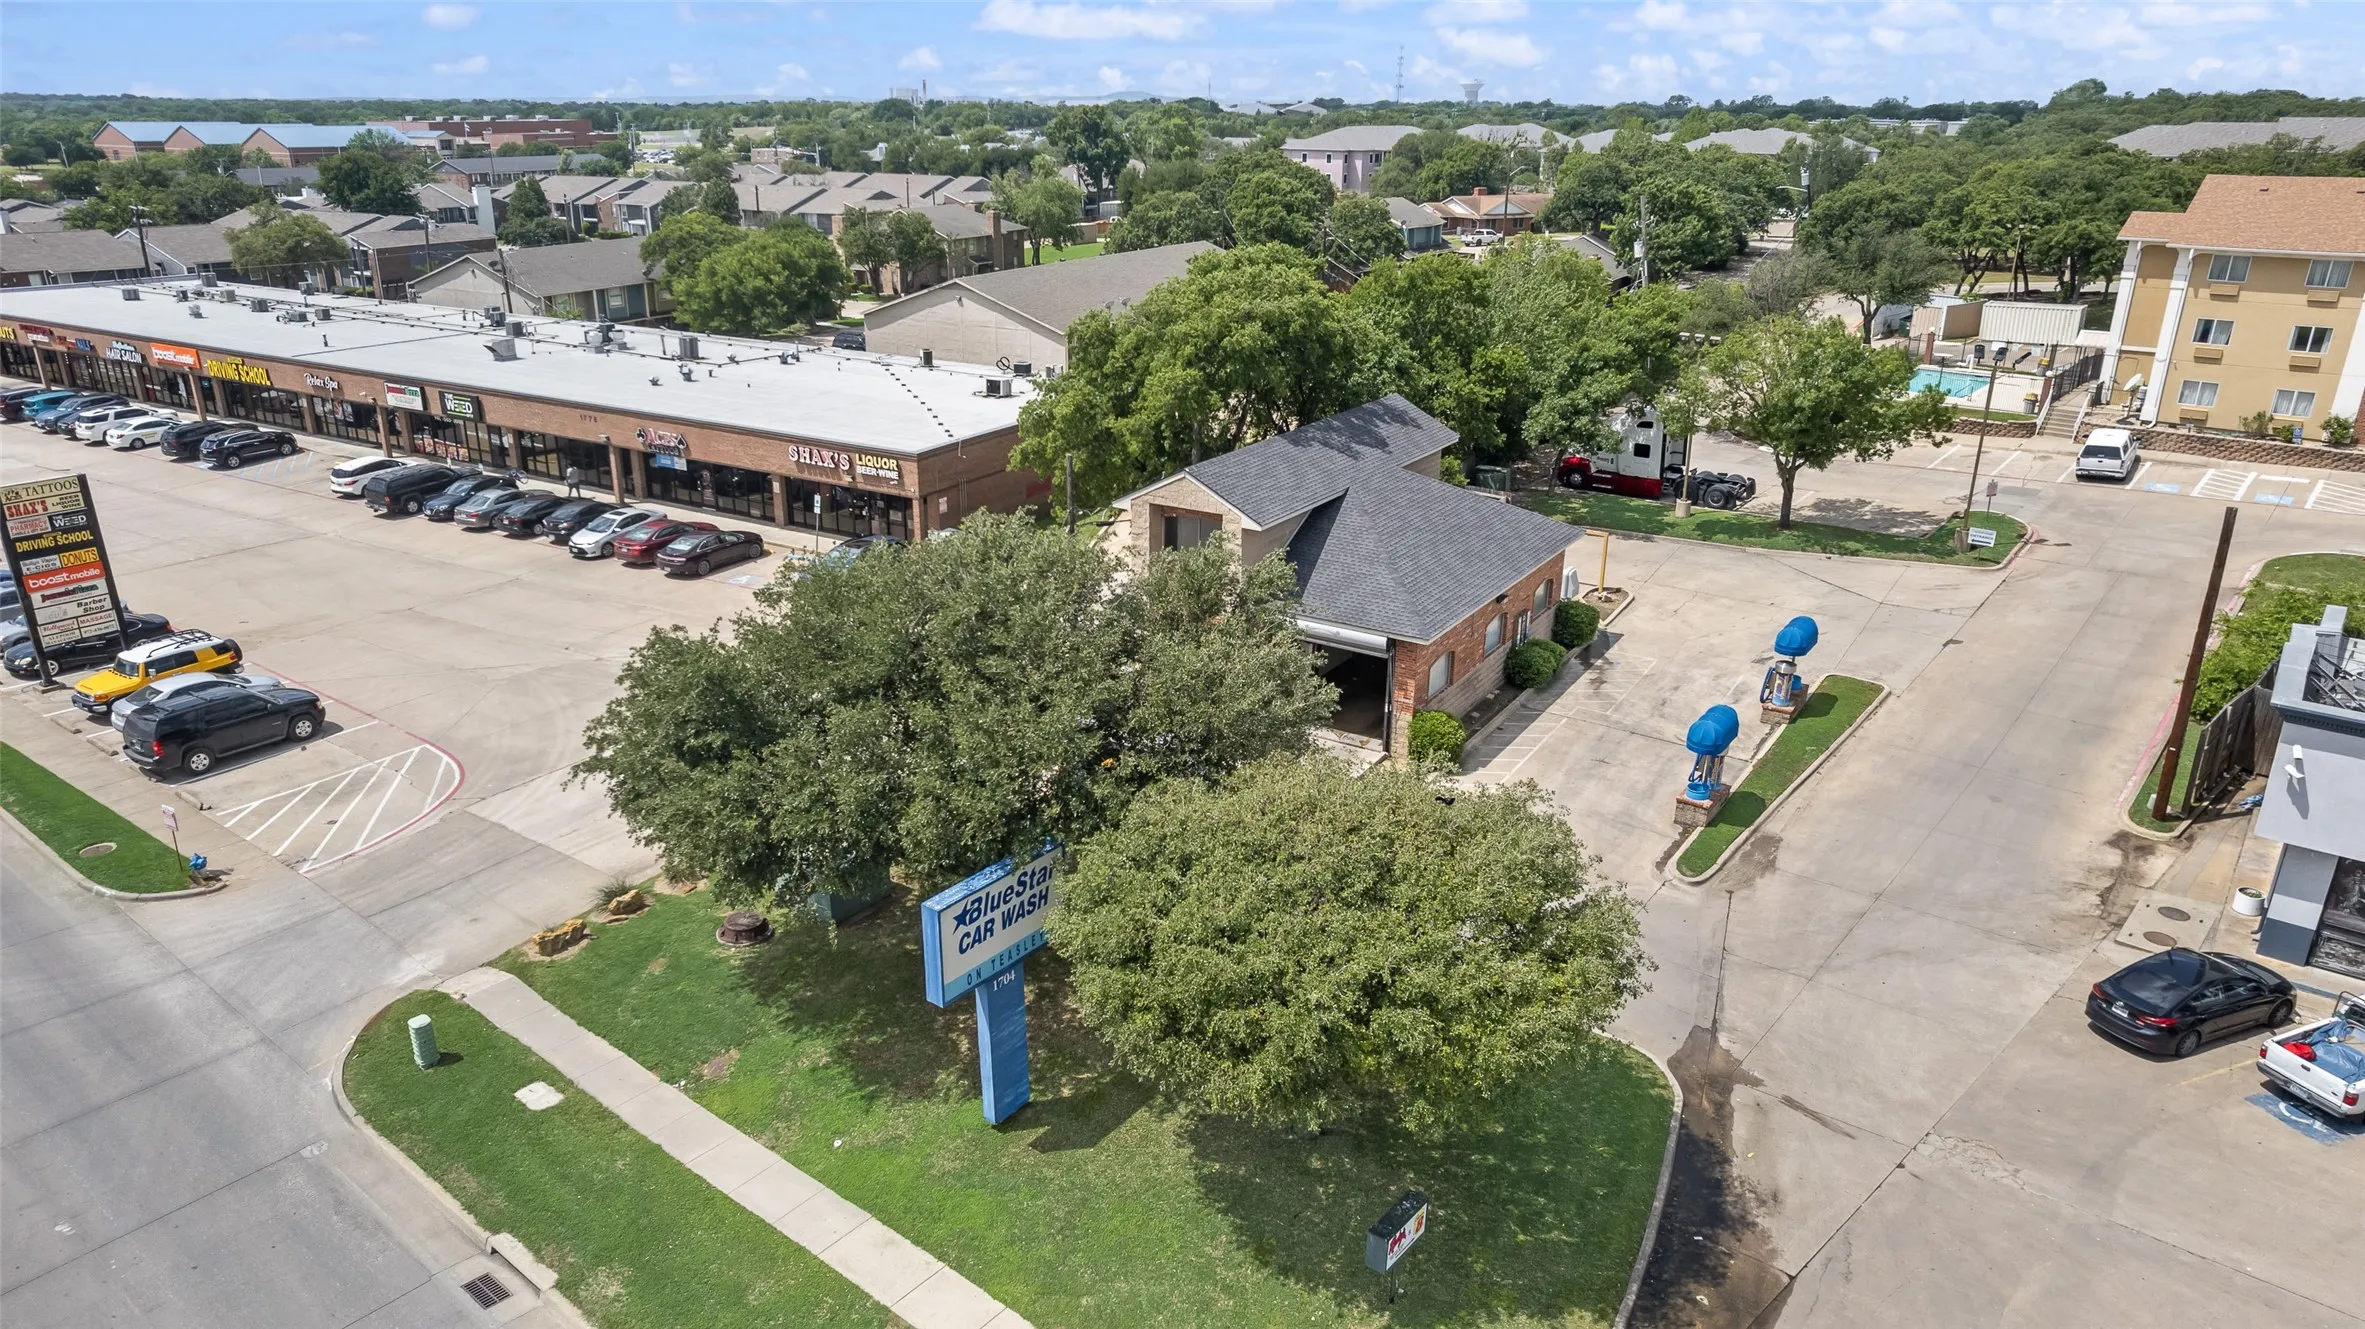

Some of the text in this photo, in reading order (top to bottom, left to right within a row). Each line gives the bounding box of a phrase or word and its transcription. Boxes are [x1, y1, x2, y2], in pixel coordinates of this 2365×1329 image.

[106, 347, 142, 363] HAIR SALON
[207, 359, 239, 380] DRIVING
[238, 364, 271, 385] SCHOOL
[304, 373, 339, 391] Relax Spa
[788, 445, 898, 471] SHAX'S LIQUOR
[22, 479, 78, 496] TATTOOS
[6, 500, 48, 518] SHAX'S
[52, 499, 80, 507] LIQUOR
[10, 519, 47, 533] PHARMACY
[15, 530, 93, 552] DRIVING SCHOOL
[61, 548, 98, 566] DONUTS
[28, 568, 101, 588] boost mobile
[77, 597, 107, 608] Barber
[83, 605, 105, 613] Shop
[43, 620, 76, 632] Hollywood
[80, 613, 113, 625] MASSAGE
[958, 885, 1049, 955] CAR WASH
[966, 931, 1044, 986] ON TEASLEY
[992, 969, 1016, 991] 1704
